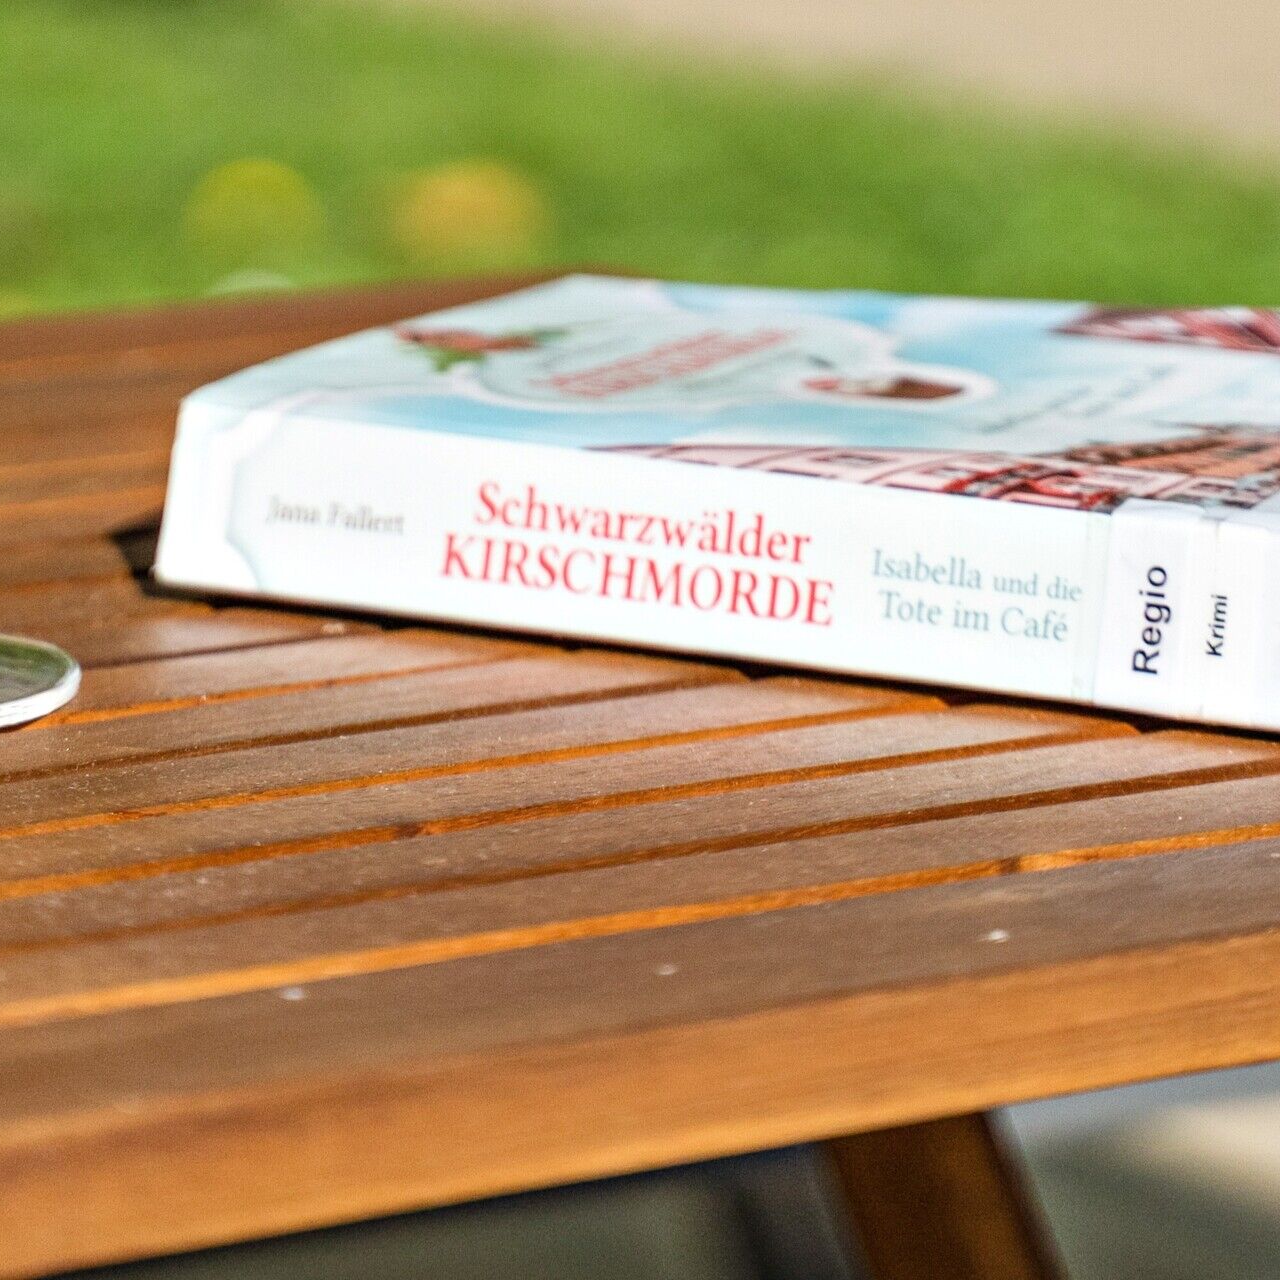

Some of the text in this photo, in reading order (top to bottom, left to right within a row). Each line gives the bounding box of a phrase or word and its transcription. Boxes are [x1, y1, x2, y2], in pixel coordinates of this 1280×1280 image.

[474, 480, 813, 564] Schwarzwälder
[439, 532, 835, 627] KIRSCHMORDE
[872, 549, 1084, 602] Isabella und die
[879, 589, 1069, 643] Tote im Café
[1131, 566, 1171, 675] Regio
[1205, 594, 1228, 657] Krimi
